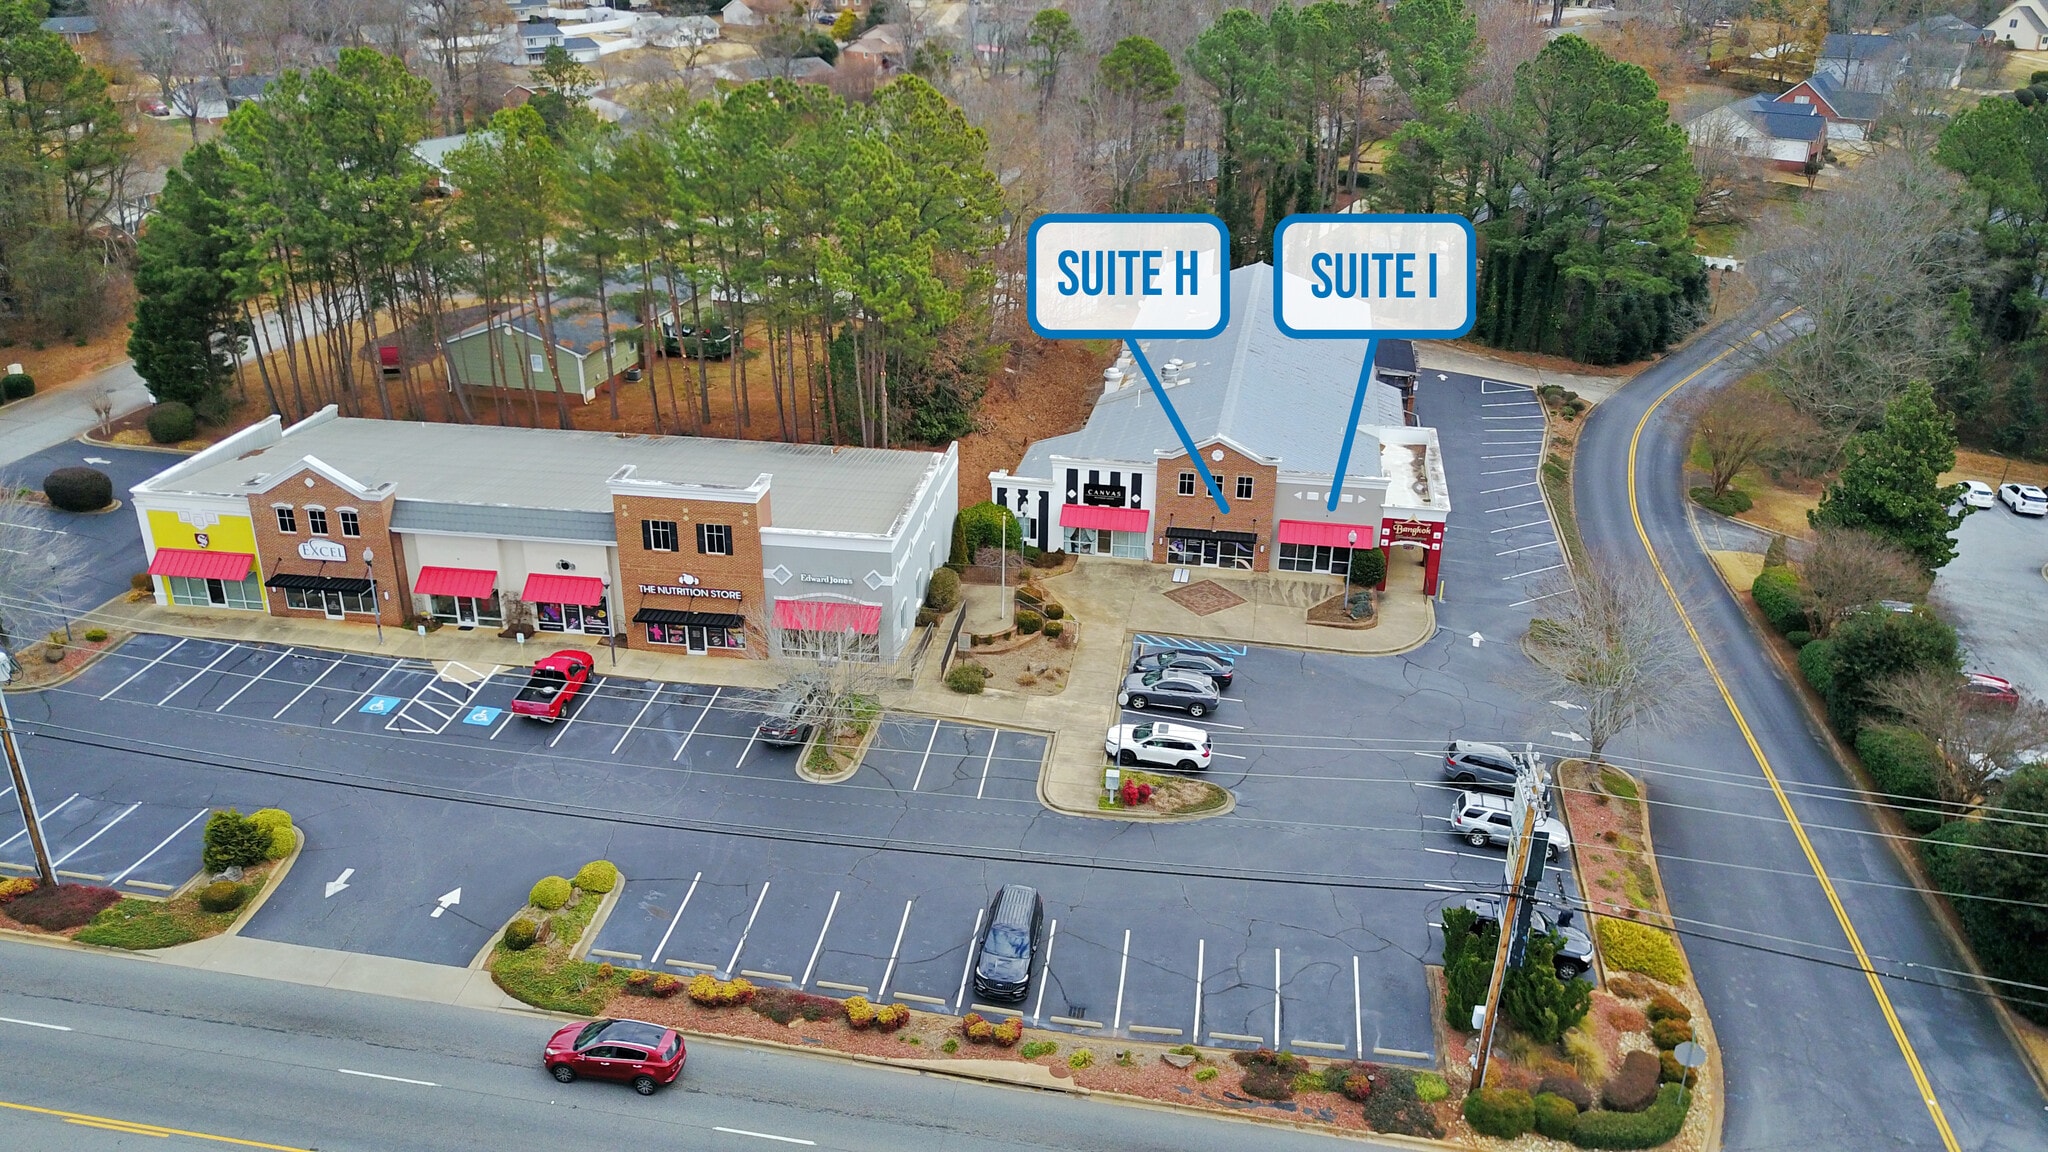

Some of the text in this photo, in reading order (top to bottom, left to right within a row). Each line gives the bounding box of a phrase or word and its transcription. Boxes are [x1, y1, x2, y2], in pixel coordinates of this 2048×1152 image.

[1087, 488, 1121, 497] CANVAS
[1393, 524, 1431, 536] Bangkok
[302, 542, 344, 558] EXCEL
[800, 573, 854, 585] Edward Jones
[638, 584, 742, 601] THE NUTRITION STORE
